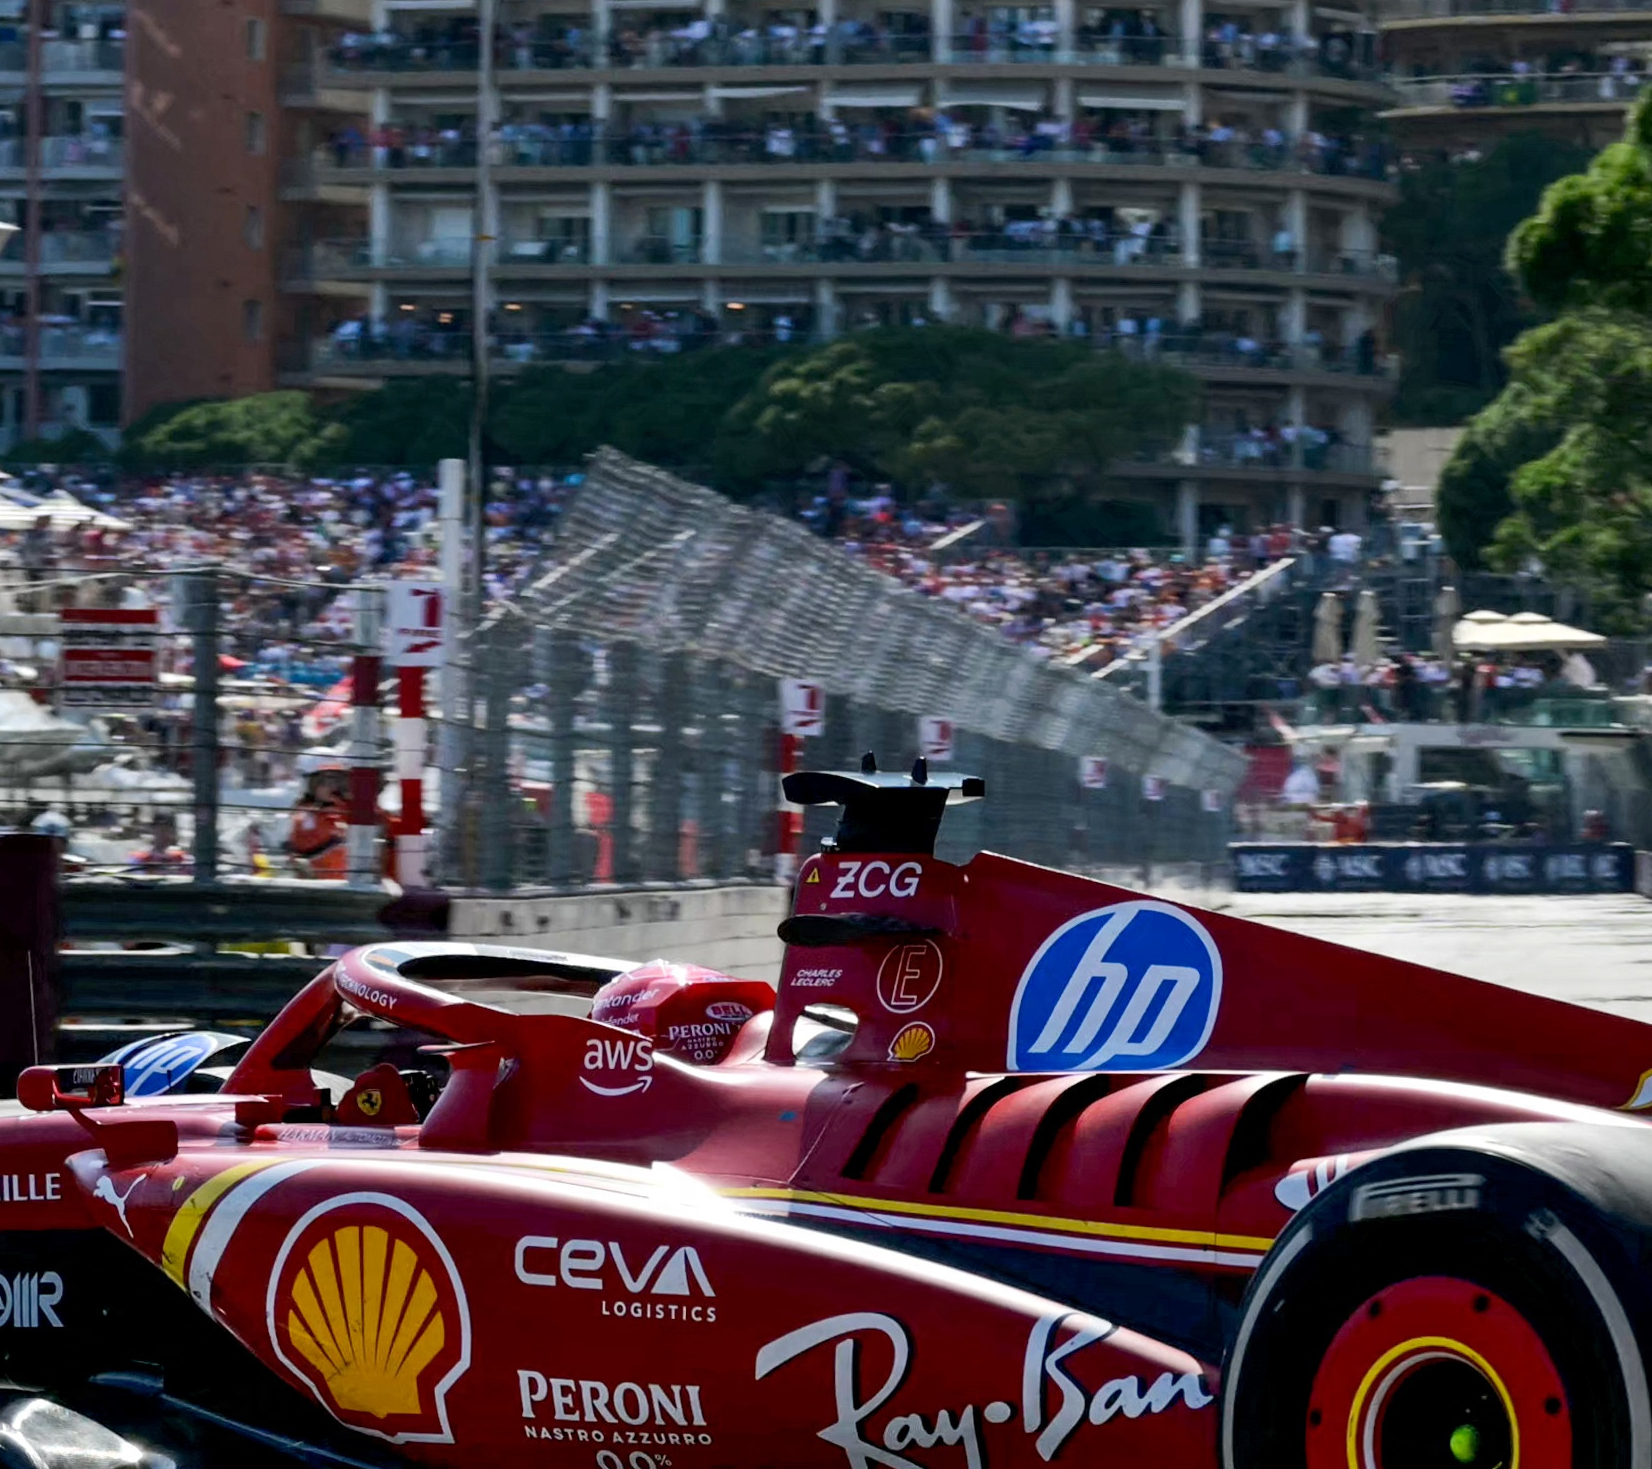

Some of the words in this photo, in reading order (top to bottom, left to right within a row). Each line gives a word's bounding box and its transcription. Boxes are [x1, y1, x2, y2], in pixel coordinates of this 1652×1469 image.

[791, 978, 836, 987] LECLERC
[797, 969, 843, 978] CHARLES
[1031, 906, 1199, 1069] hp
[668, 1023, 731, 1040] PERONI
[584, 1038, 654, 1072] aws
[601, 1300, 717, 1323] LOGISTICS
[516, 1369, 707, 1426] PERONI
[524, 1425, 605, 1443] NASTRO
[612, 1431, 713, 1446] AZZURRO
